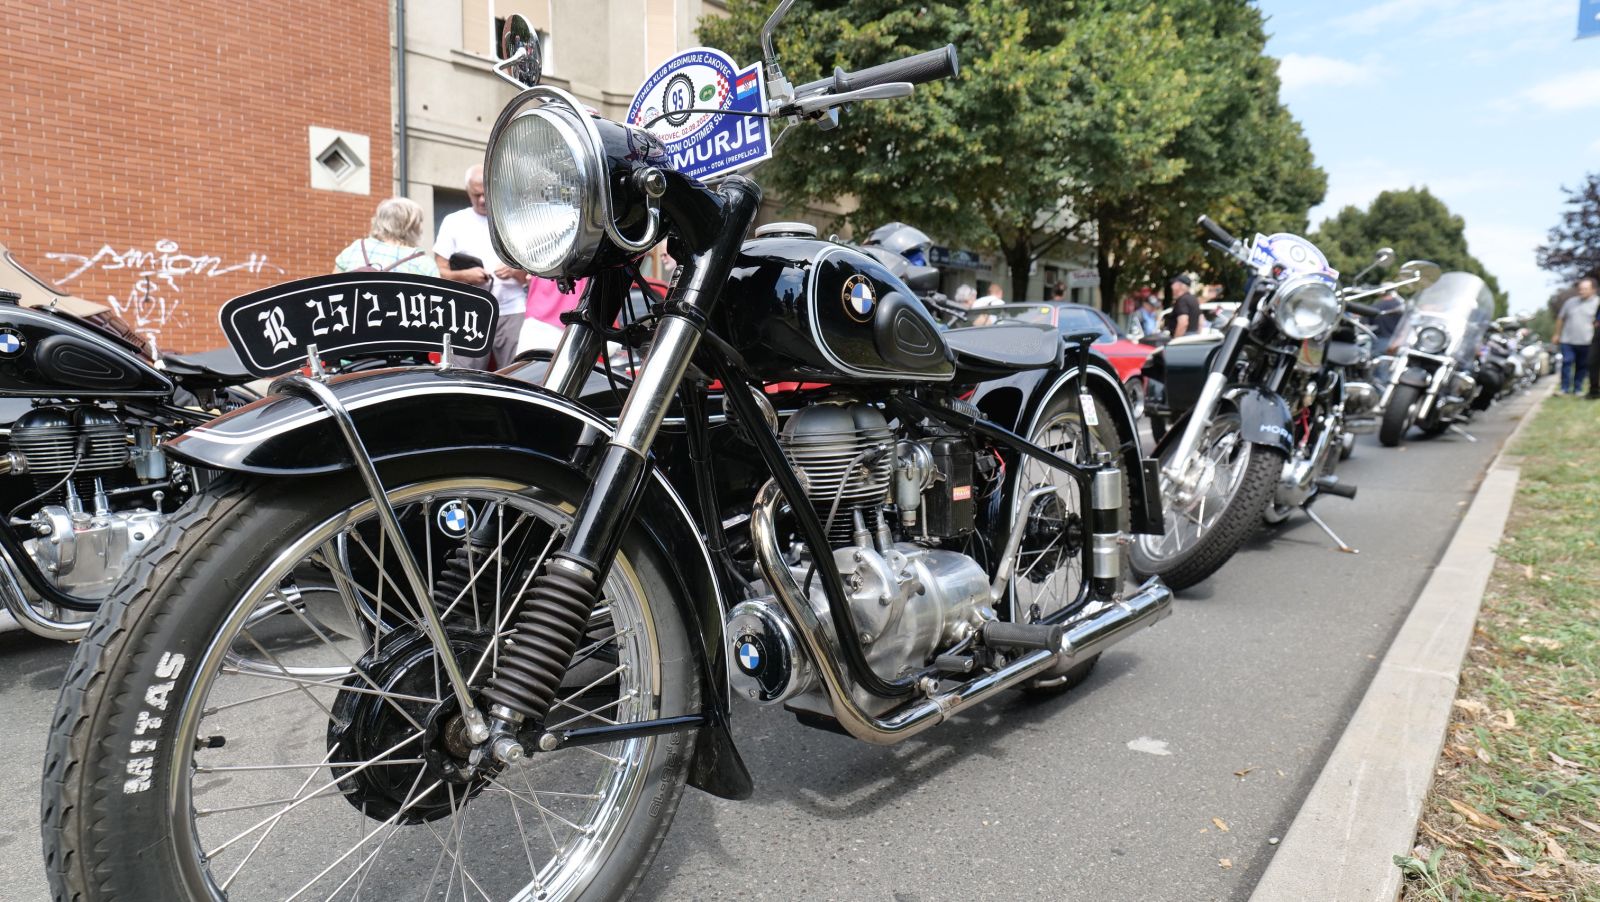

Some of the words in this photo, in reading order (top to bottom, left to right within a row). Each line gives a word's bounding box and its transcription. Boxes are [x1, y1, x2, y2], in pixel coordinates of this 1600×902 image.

[630, 82, 654, 119] OLDTIMER
[653, 68, 667, 83] KLUB
[703, 53, 732, 78] ČAKOVEC
[672, 88, 684, 111] 95
[665, 142, 683, 154] ODNI
[682, 122, 715, 148] OLDTIMER
[713, 92, 735, 126] SURET
[673, 107, 762, 170] MURJE
[684, 166, 708, 178] UBRAVA
[711, 160, 725, 169] OTOK
[725, 146, 760, 165] (PREPELICA)
[257, 306, 297, 355] R
[123, 651, 187, 795] MITAS
